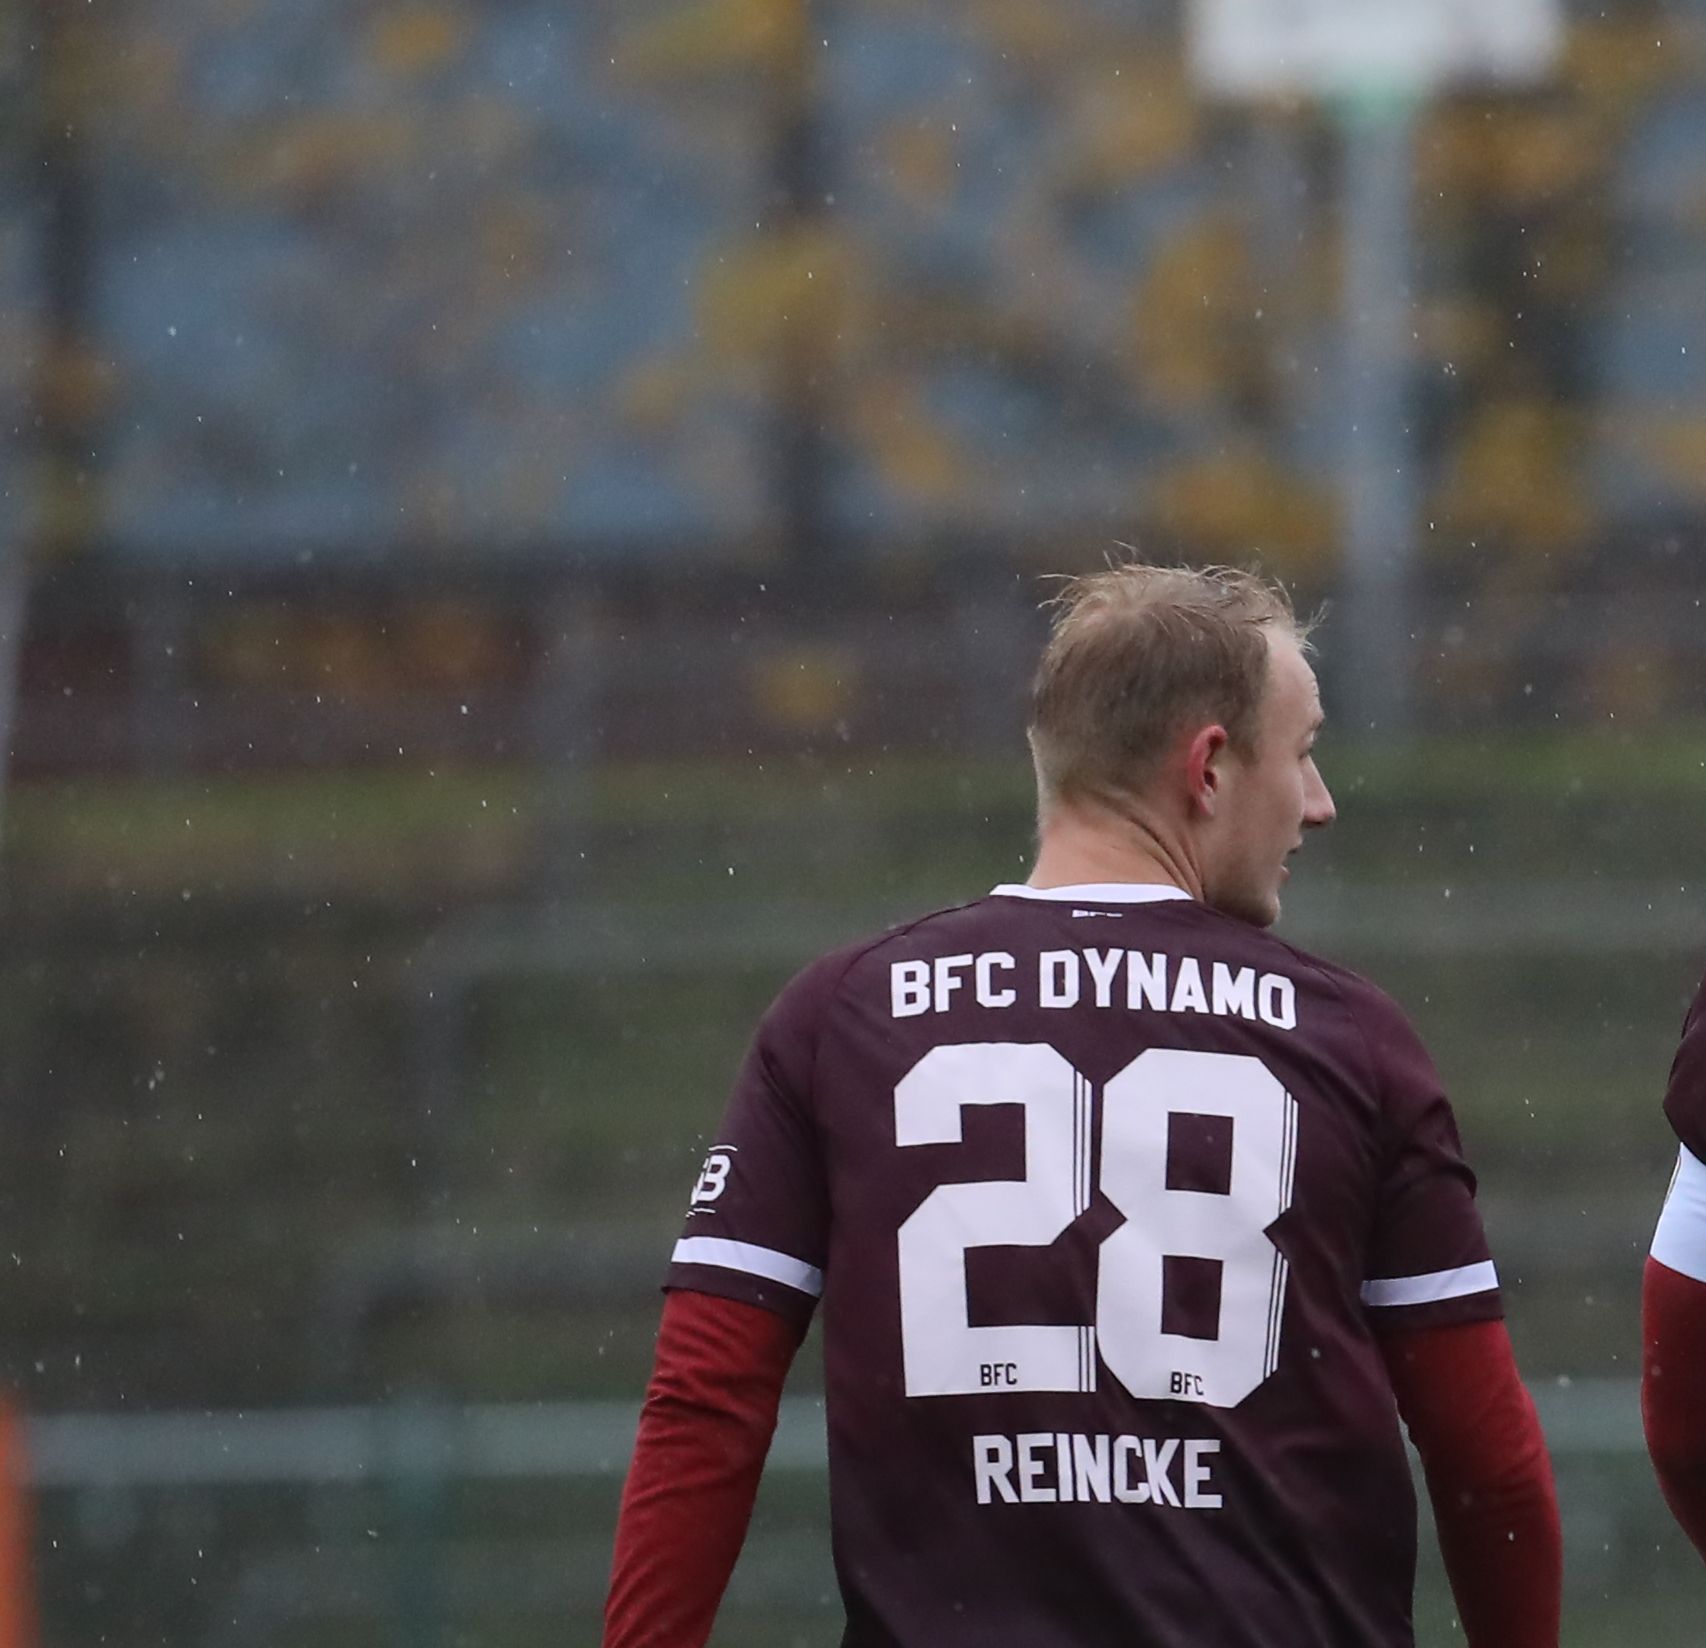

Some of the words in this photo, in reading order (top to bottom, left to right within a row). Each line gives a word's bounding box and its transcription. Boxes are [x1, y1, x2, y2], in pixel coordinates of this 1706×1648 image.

[891, 951, 1015, 1018] BFC
[1038, 948, 1297, 1030] DYNAMO
[894, 1042, 1298, 1408] 28
[980, 1363, 1018, 1387] BFC
[1169, 1371, 1205, 1396] BFC
[973, 1433, 1223, 1509] REINCKE
